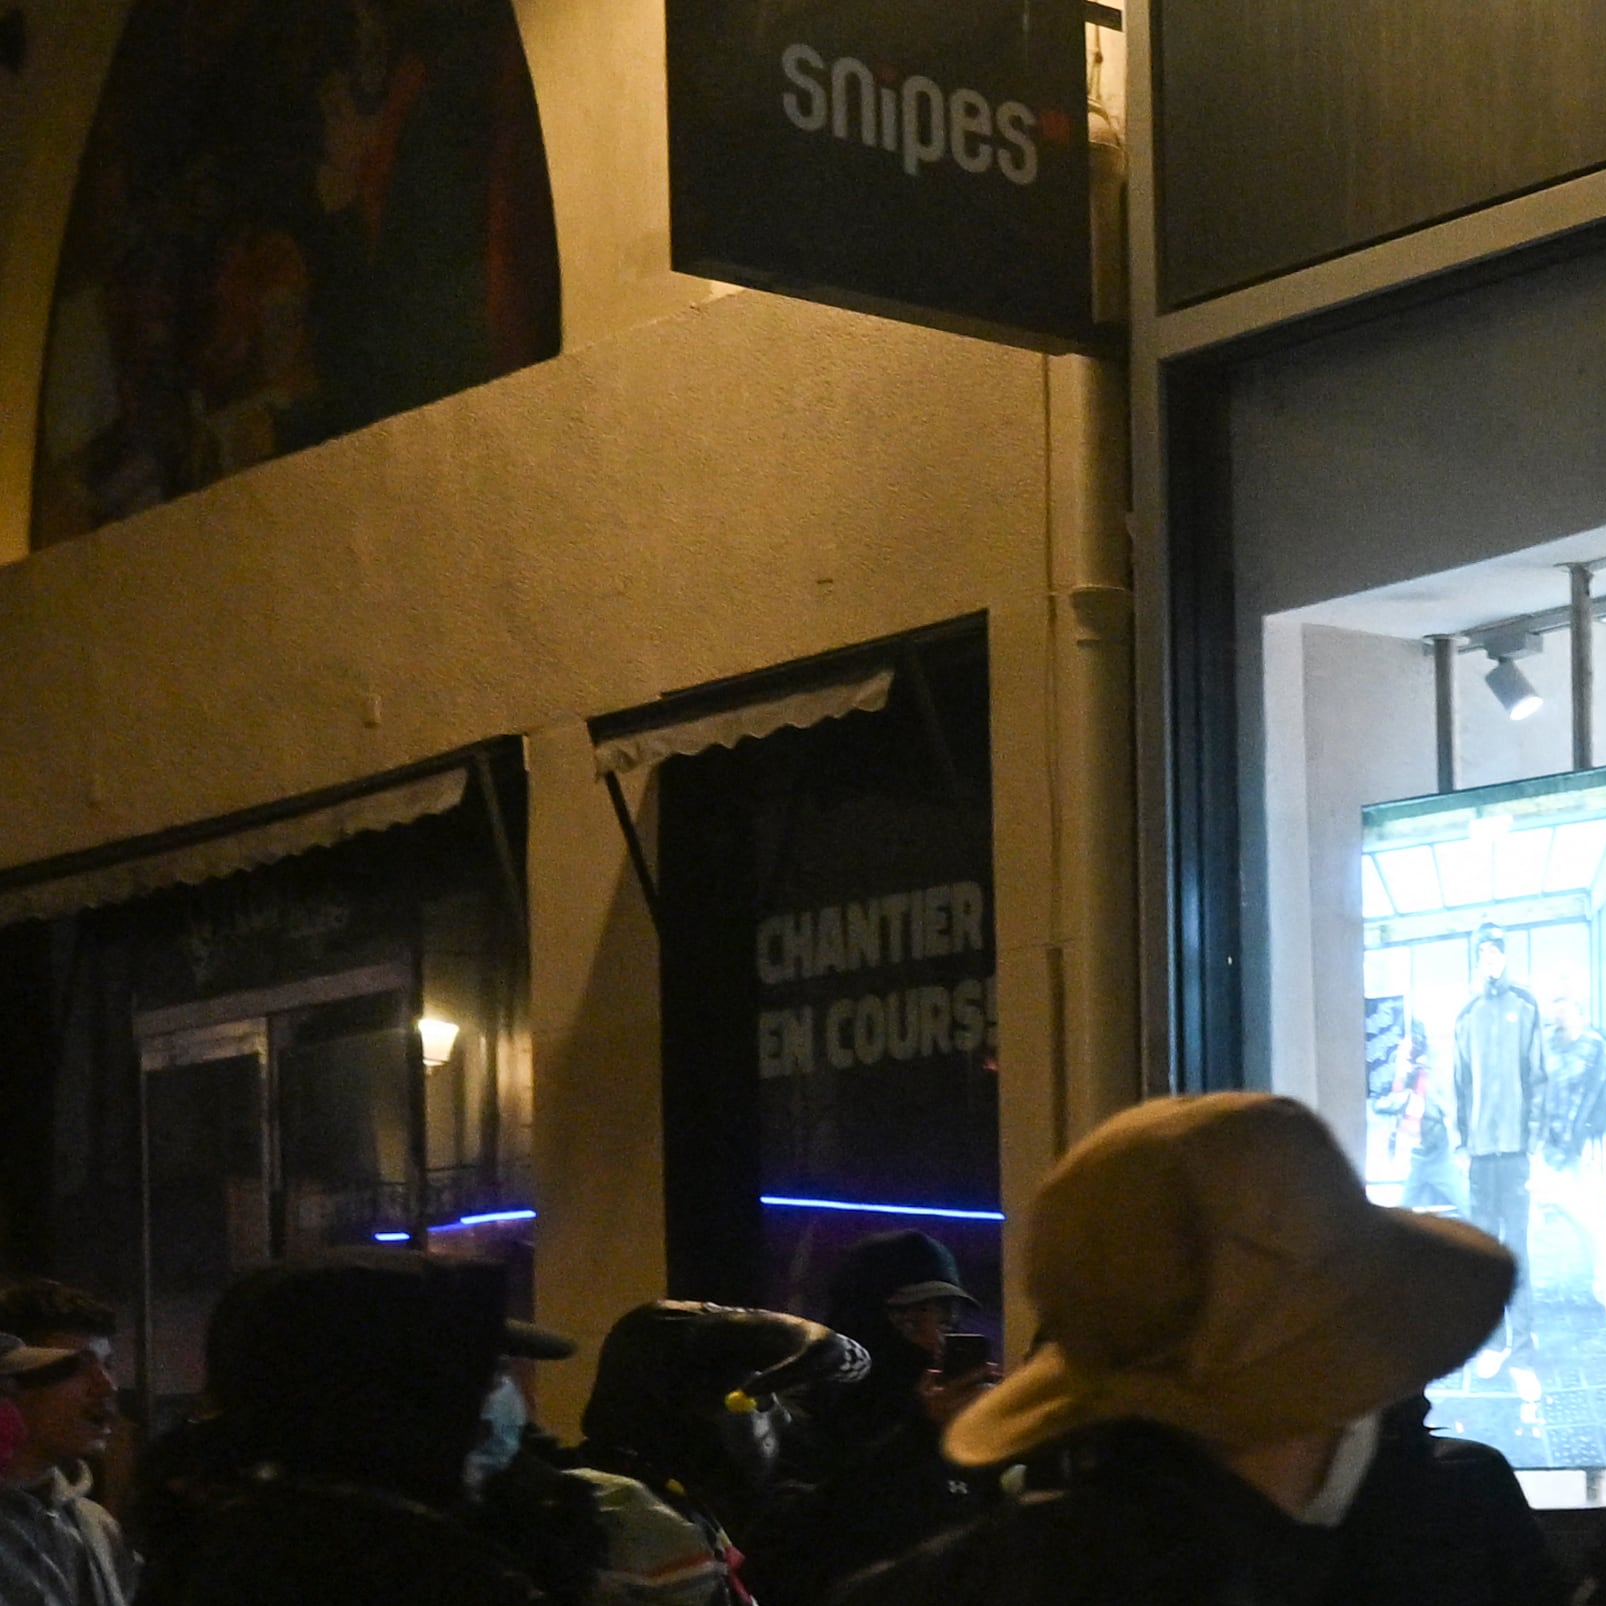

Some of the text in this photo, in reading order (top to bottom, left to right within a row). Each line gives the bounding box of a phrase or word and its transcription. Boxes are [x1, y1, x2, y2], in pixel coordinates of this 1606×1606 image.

[781, 43, 1038, 185] snipes
[756, 880, 984, 984] CHANTIER
[758, 1004, 816, 1080] EN
